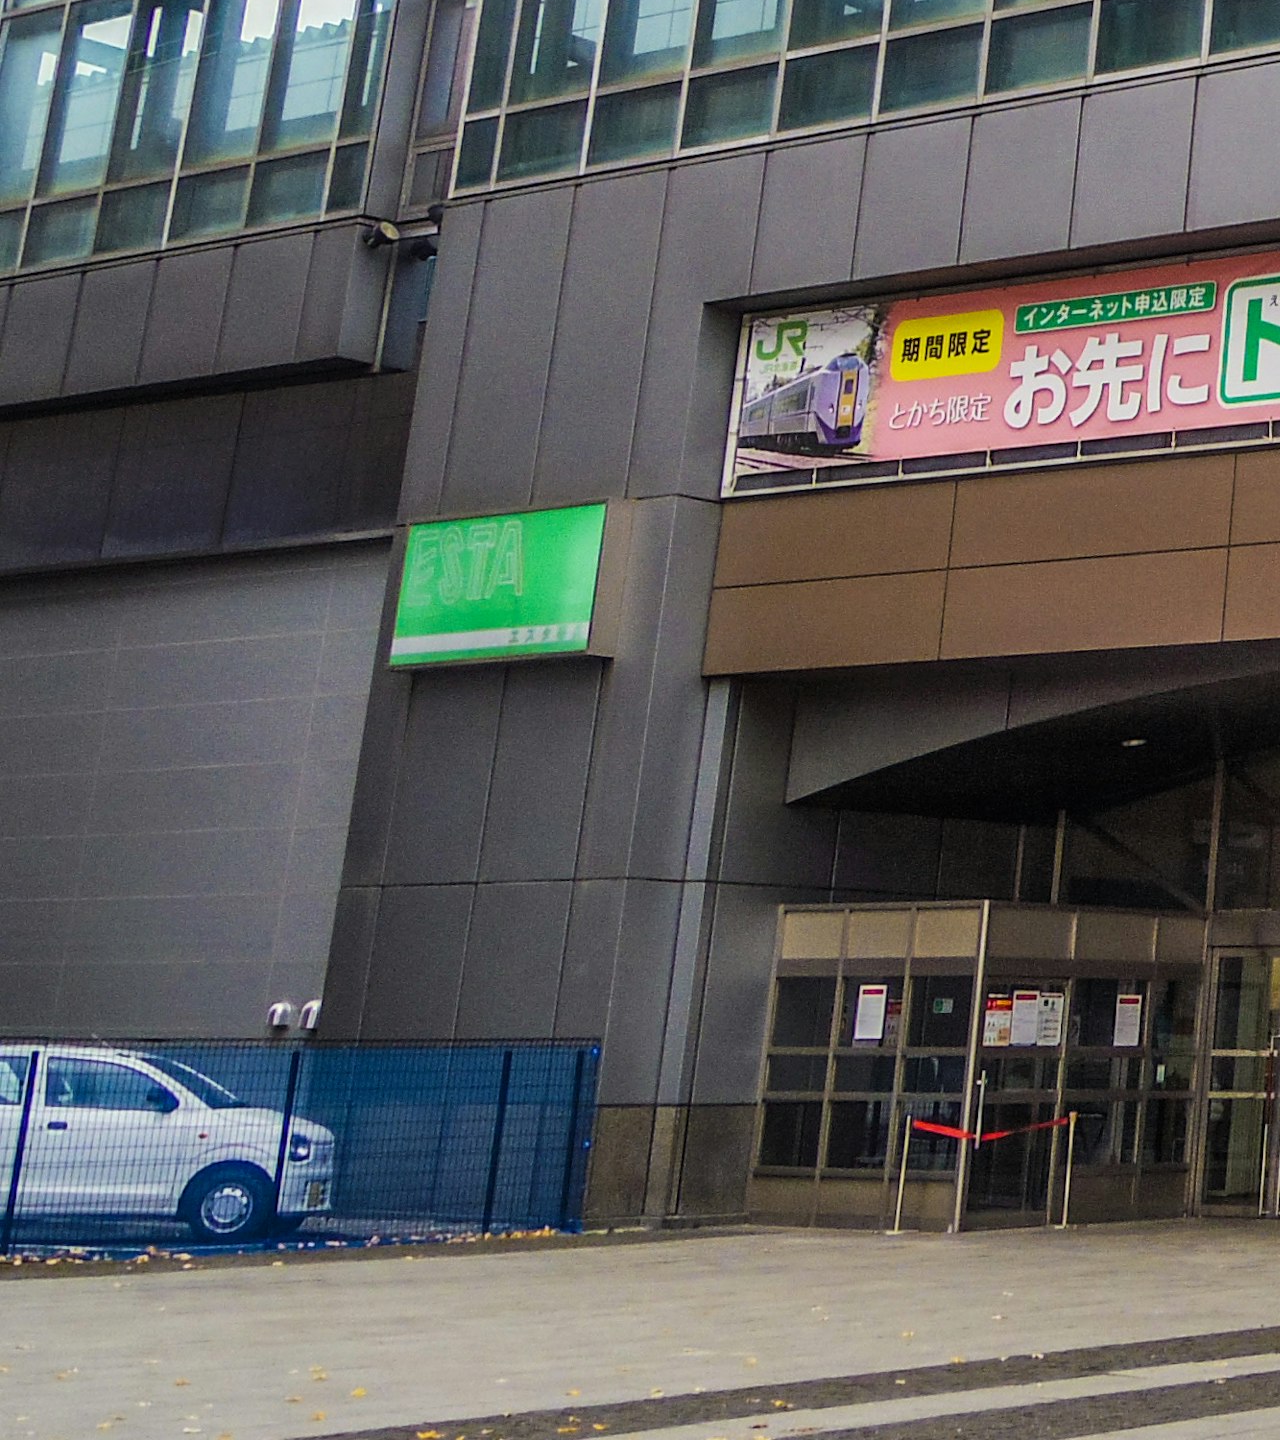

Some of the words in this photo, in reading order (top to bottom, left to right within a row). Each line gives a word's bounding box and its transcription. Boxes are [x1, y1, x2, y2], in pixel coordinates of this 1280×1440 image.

[1023, 287, 1206, 329] インターネット申込限定
[756, 320, 808, 361] JR
[901, 328, 992, 363] 期間限定
[1003, 332, 1211, 430] お先に
[888, 392, 993, 429] とかち限定
[406, 519, 523, 608] ESTA
